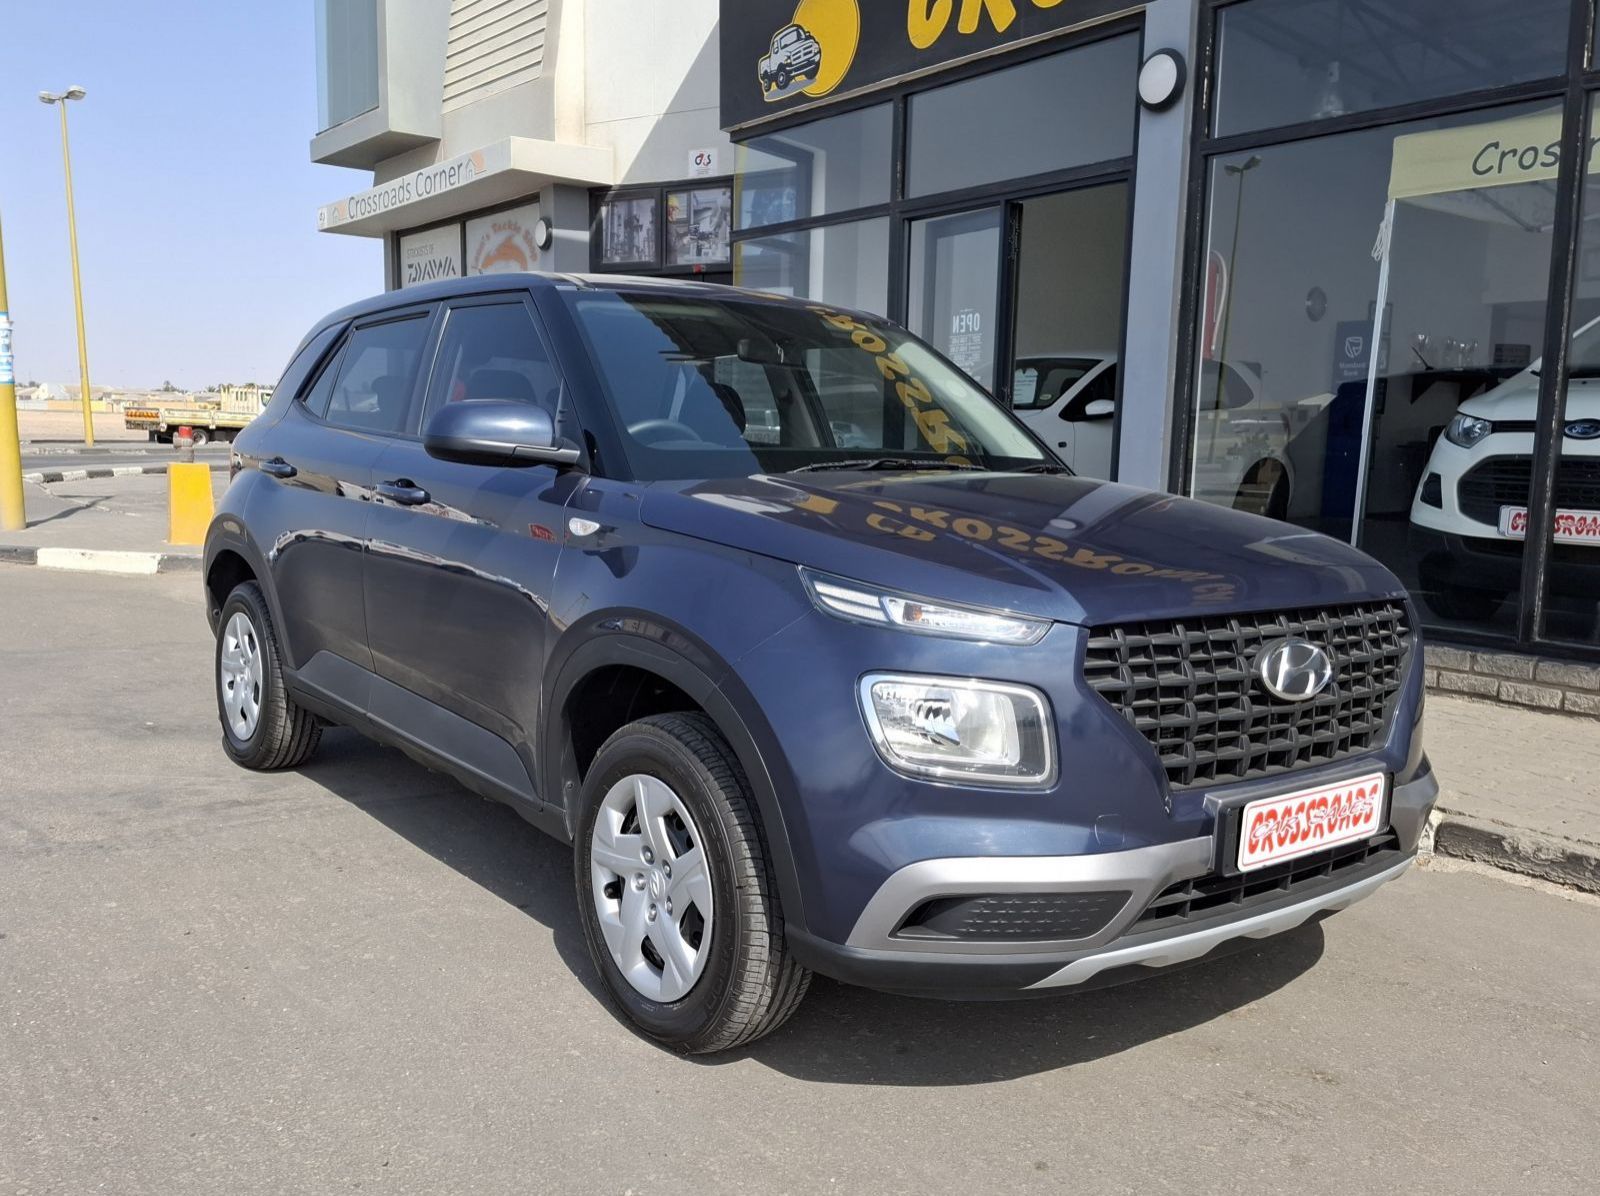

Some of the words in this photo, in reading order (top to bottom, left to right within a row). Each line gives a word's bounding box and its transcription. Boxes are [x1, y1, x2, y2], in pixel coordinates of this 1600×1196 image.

[347, 178, 411, 220] Crossroads
[415, 161, 463, 198] Corner
[1571, 424, 1595, 434] Ford
[1248, 783, 1379, 854] CROSSROADS
